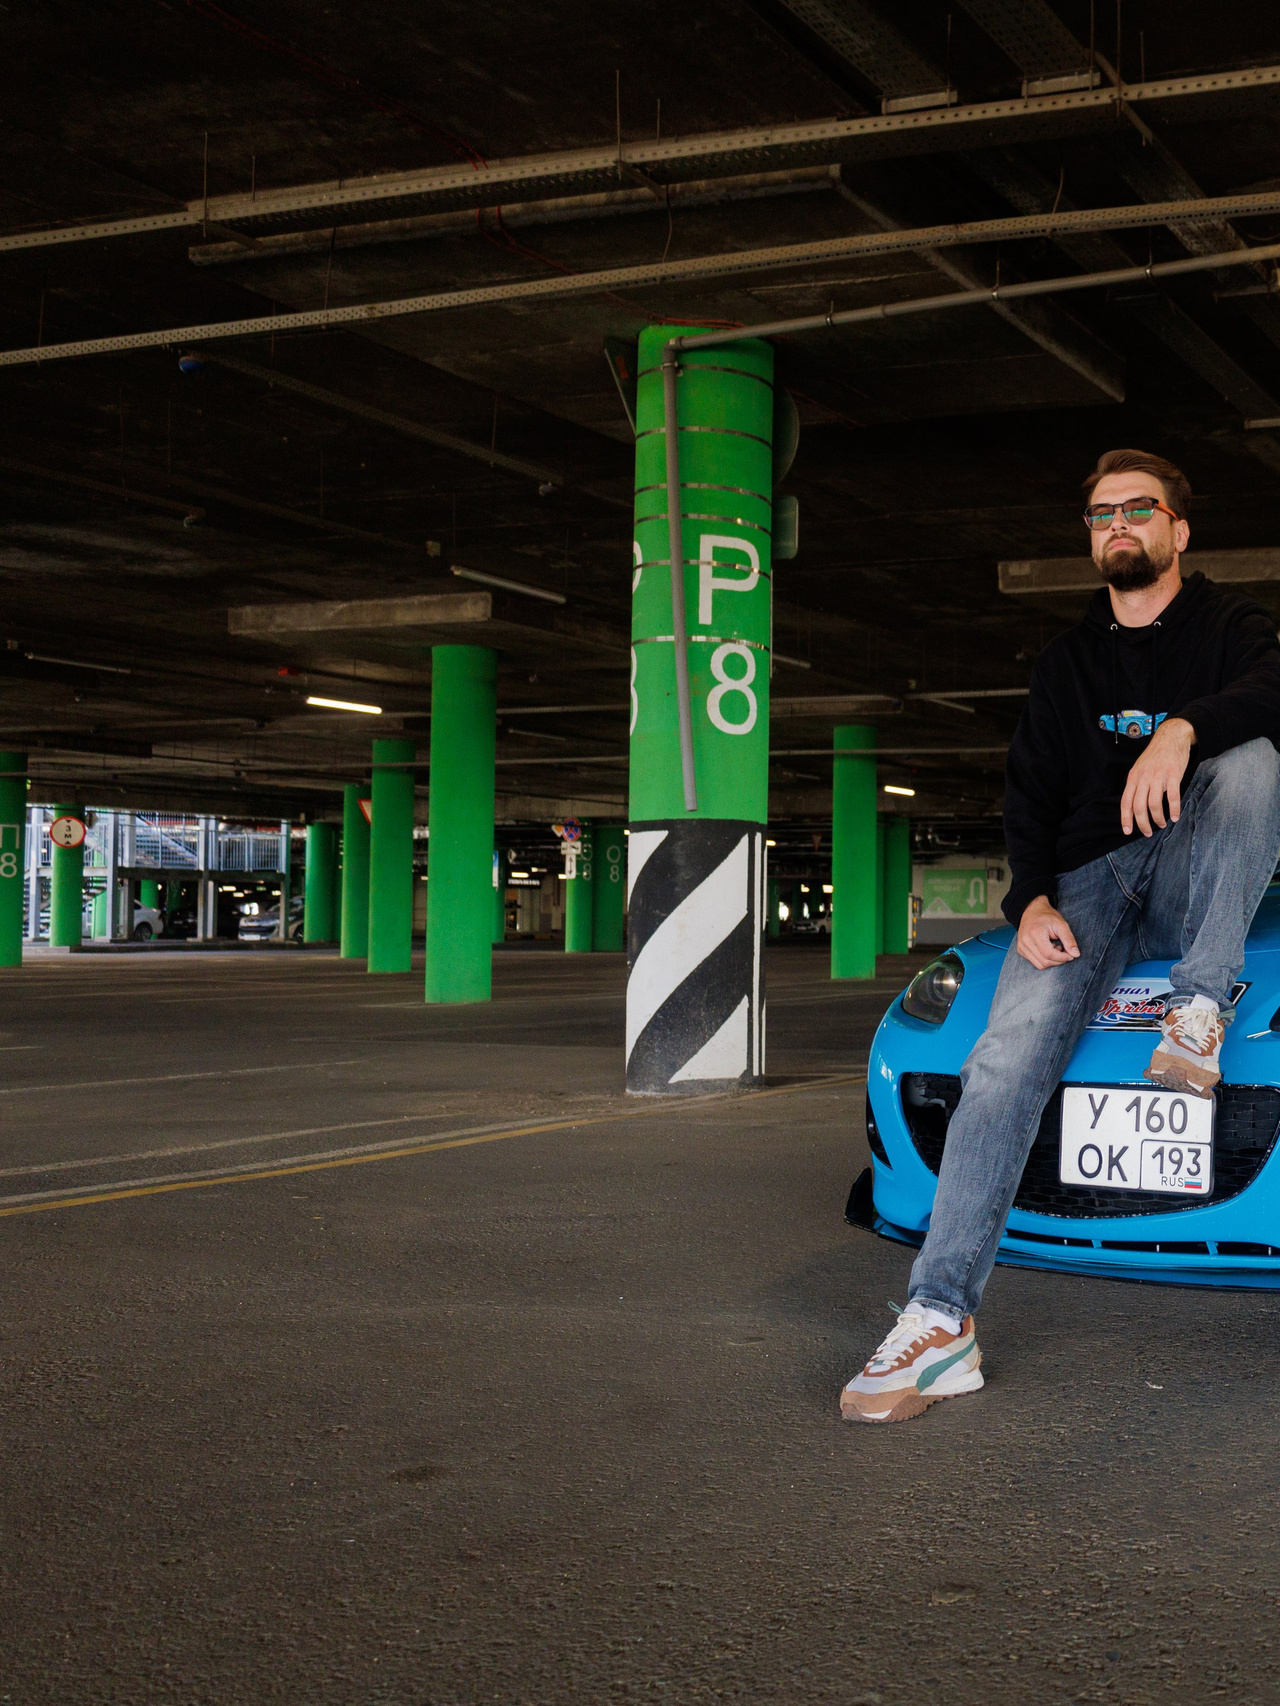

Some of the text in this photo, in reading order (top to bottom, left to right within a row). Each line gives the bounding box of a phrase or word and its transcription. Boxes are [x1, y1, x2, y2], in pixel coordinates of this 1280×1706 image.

[706, 643, 757, 735] 8
[0, 852, 17, 878] 8
[609, 865, 620, 883] 8
[1097, 999, 1165, 1016] Sprint
[1125, 1095, 1189, 1135] 160
[1151, 1145, 1202, 1177] 193
[1161, 1176, 1184, 1188] RUS
